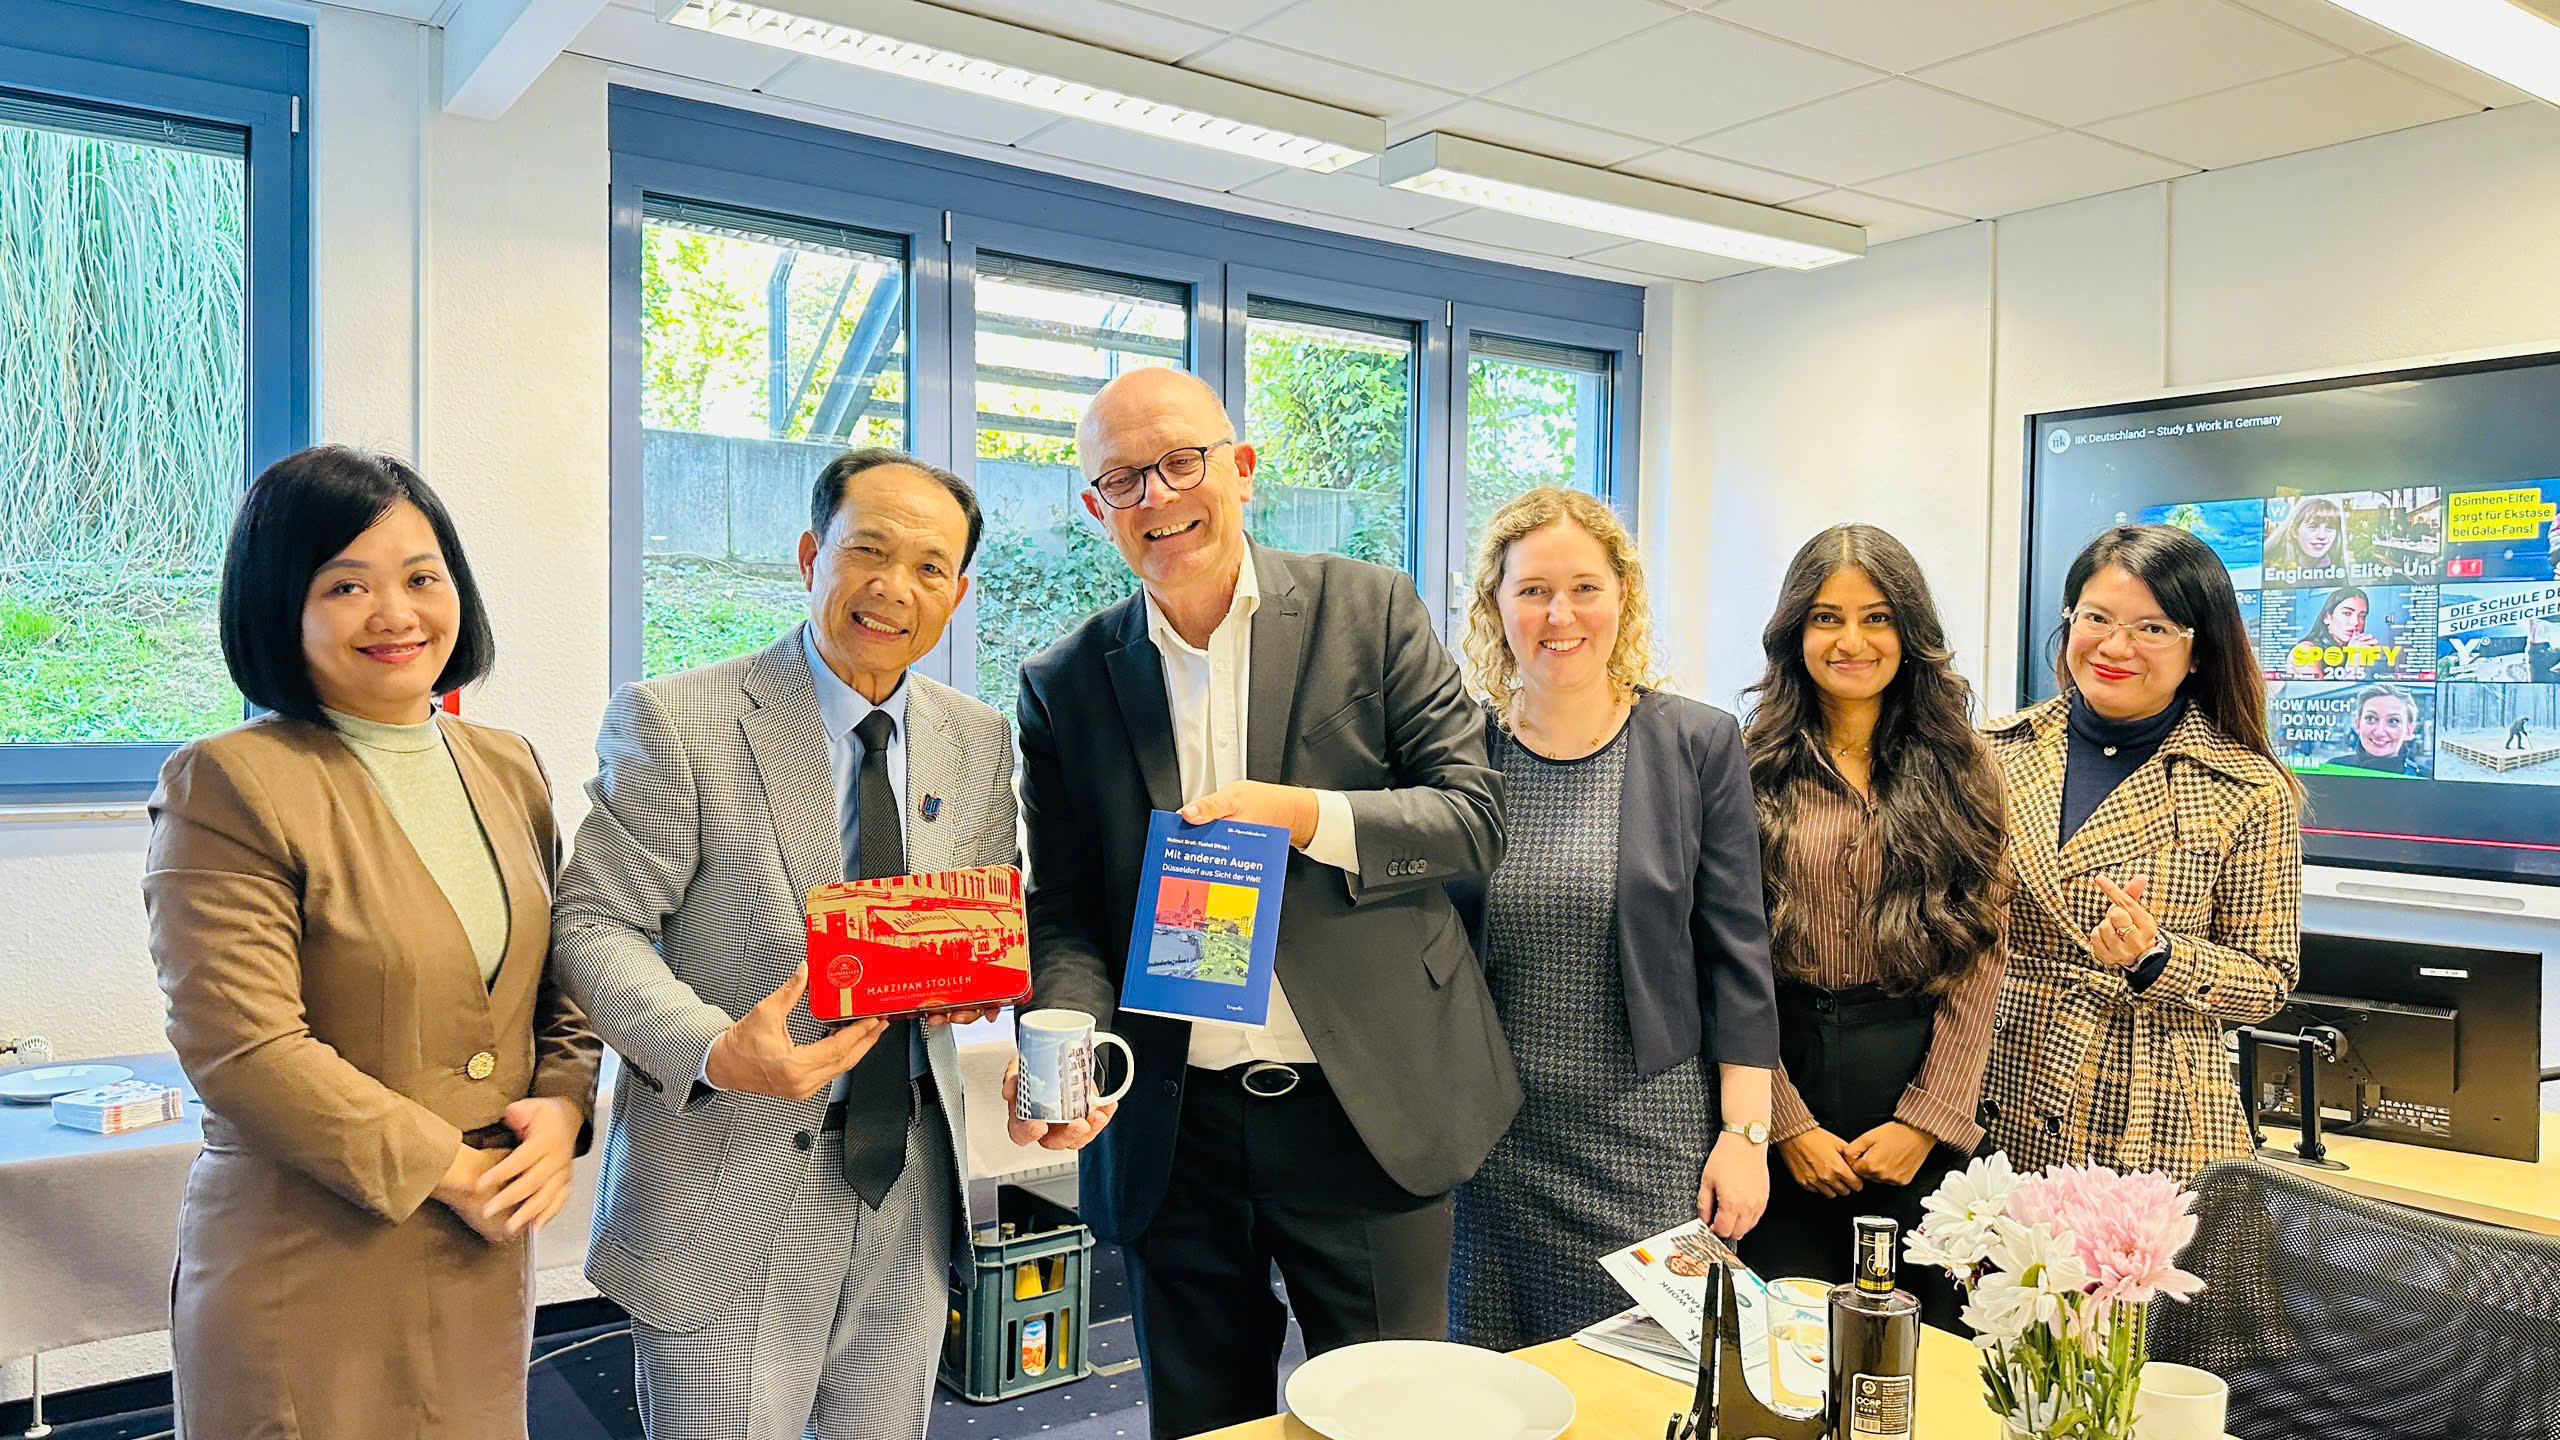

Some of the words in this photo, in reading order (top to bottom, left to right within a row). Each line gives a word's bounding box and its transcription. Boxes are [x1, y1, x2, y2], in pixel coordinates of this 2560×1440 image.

[2088, 428, 2146, 443] Deutschland
[2156, 425, 2184, 437] Study
[2185, 423, 2194, 433] &
[2195, 420, 2222, 432] Work
[2223, 419, 2233, 430] in
[2235, 415, 2283, 428] Germany
[2453, 511, 2483, 524] sorgt
[2485, 510, 2502, 521] für
[2504, 507, 2551, 520] Ekstase
[2453, 526, 2470, 538] bei
[2472, 523, 2534, 537] Gala-Fans!
[2264, 564, 2346, 585] Englands
[2350, 558, 2437, 577] Elite-Uni
[2450, 604, 2474, 618] DIE
[2479, 591, 2541, 612] SCHULE
[2450, 603, 2560, 632] SUPERREICHE
[2292, 645, 2402, 667] SPOTIFY
[2323, 666, 2367, 681] 2025
[2270, 699, 2305, 713] HOW
[2306, 699, 2350, 713] MUCH
[2281, 713, 2304, 727] DO
[2305, 714, 2337, 727] YOU
[2286, 728, 2332, 742] EARN?
[1164, 848, 1182, 860] Mit
[1183, 852, 1228, 866] anderen
[1229, 857, 1264, 872] Augen
[1161, 863, 1200, 875] Düsseldorf
[1200, 868, 1214, 877] aus
[1214, 870, 1232, 880] Sicht
[1232, 872, 1245, 881] der
[1245, 874, 1262, 884] Welt
[866, 980, 922, 996] MARZIPAN
[925, 975, 973, 989] STOLLEN
[1658, 1280, 1688, 1308] WORK
